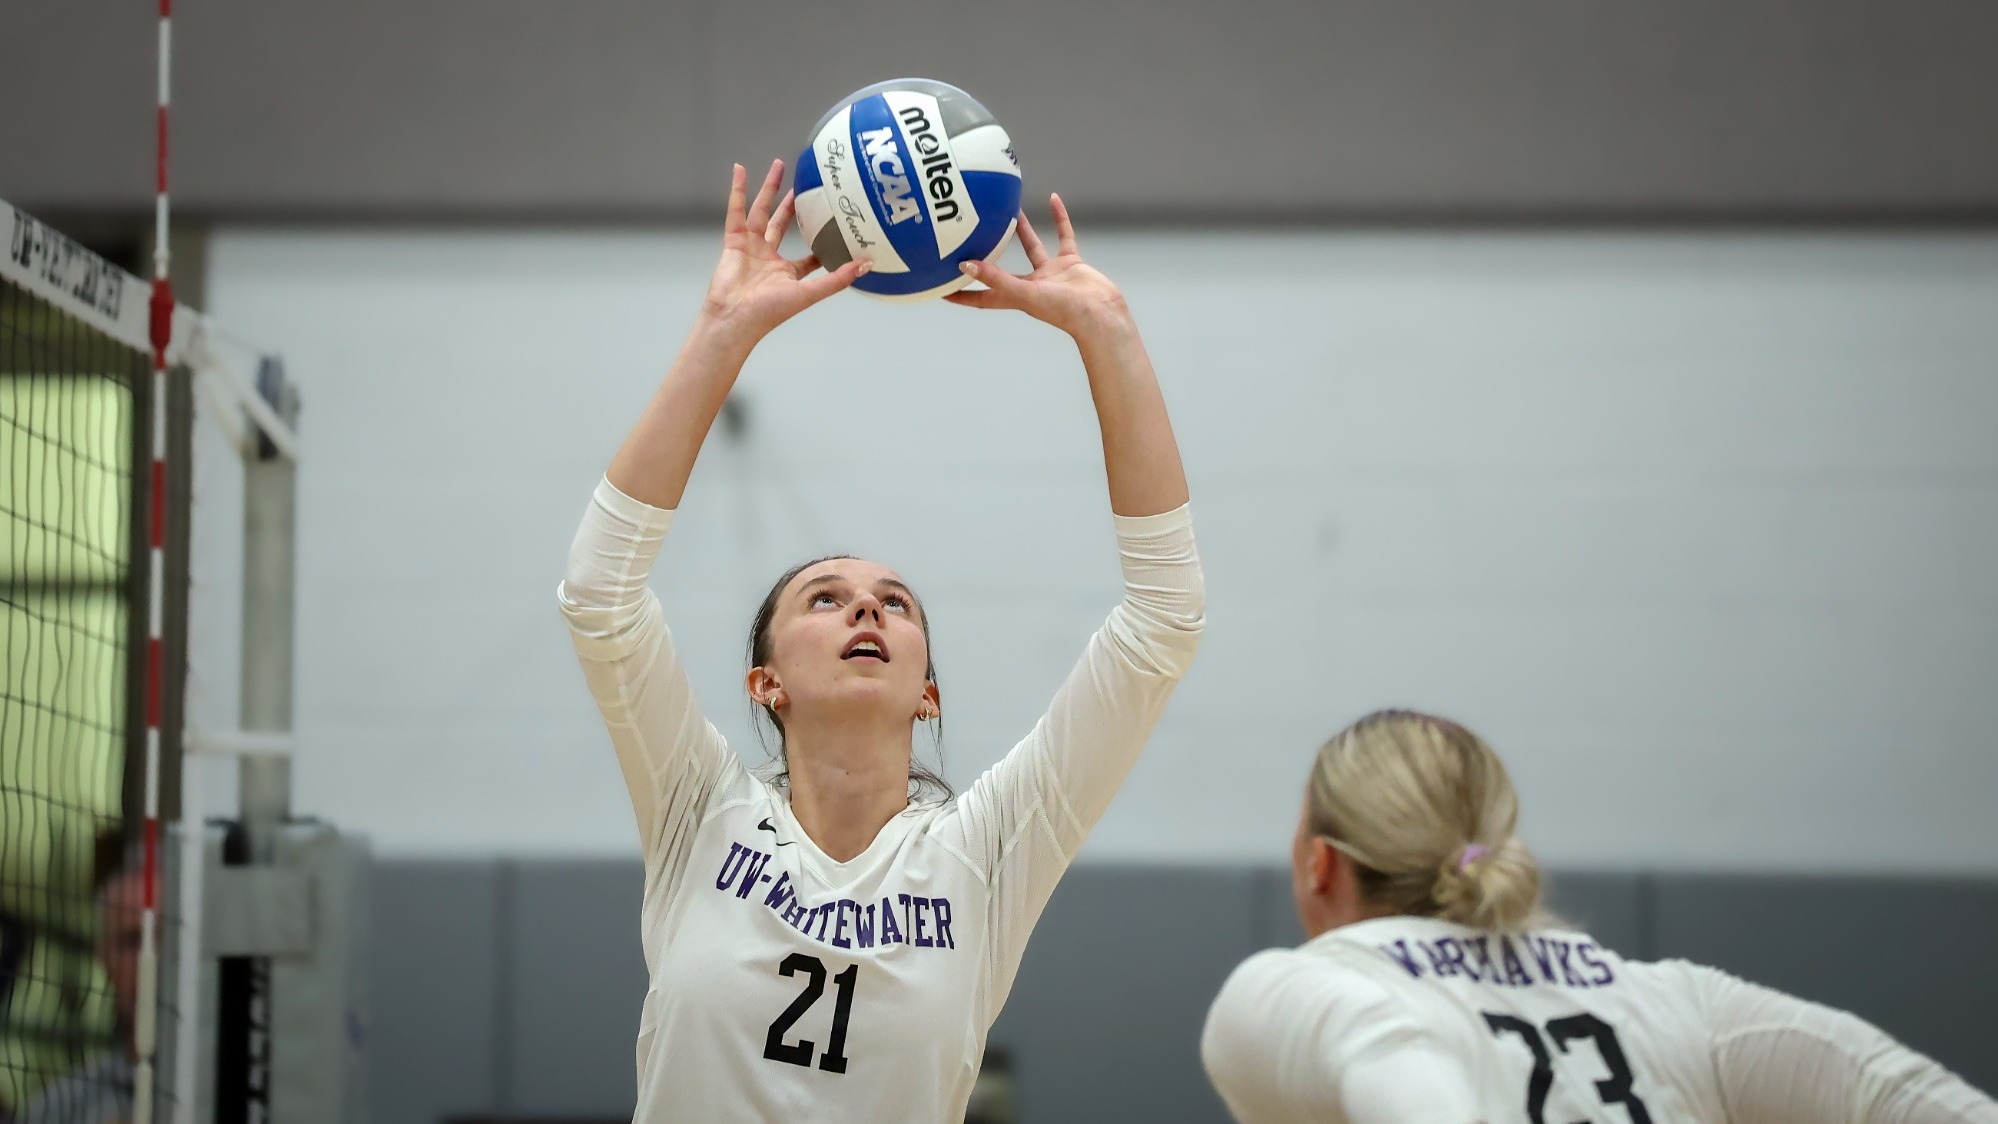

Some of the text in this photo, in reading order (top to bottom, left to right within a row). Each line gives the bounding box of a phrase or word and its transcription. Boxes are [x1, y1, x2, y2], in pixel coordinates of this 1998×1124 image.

[824, 138, 845, 191] Super
[838, 195, 876, 249] Touch
[861, 126, 920, 225] NCAA
[899, 106, 959, 222] molten
[716, 841, 955, 950] UW-WHITEWATER
[763, 952, 859, 1074] 21
